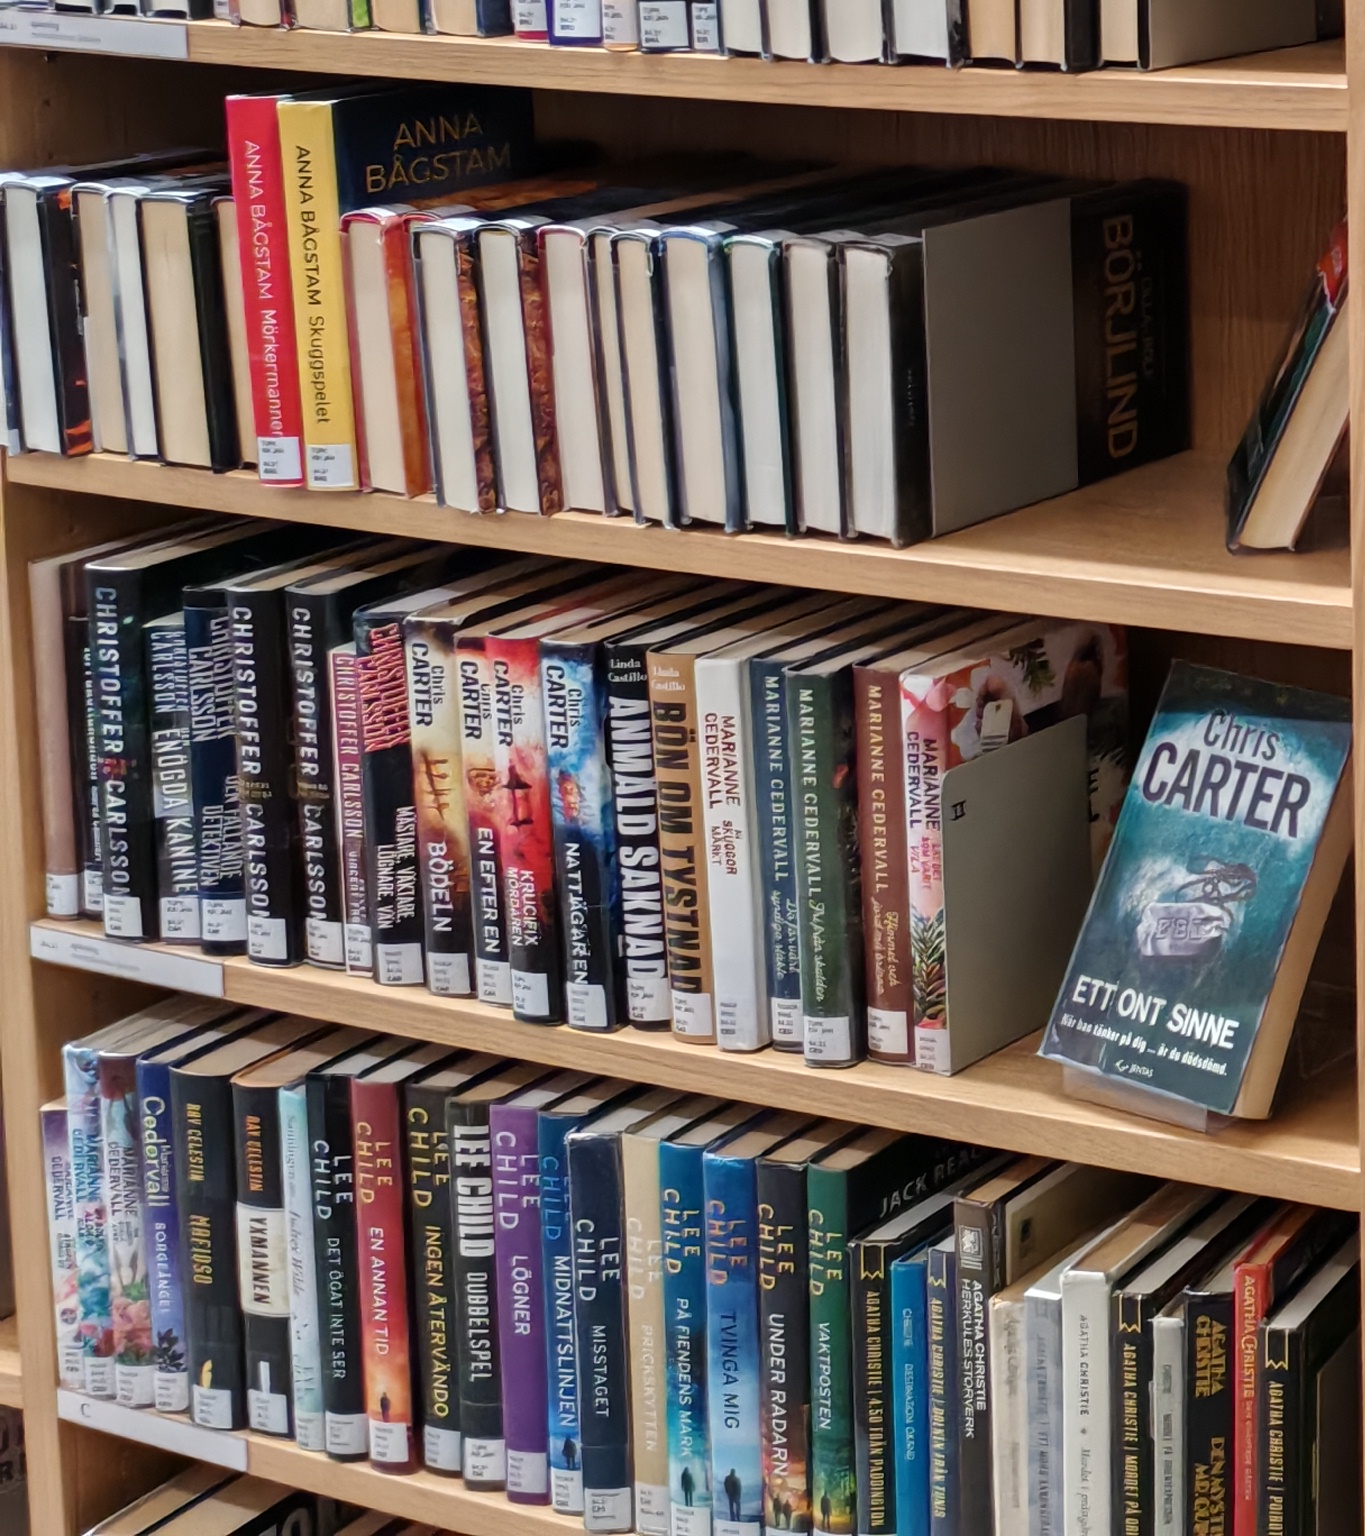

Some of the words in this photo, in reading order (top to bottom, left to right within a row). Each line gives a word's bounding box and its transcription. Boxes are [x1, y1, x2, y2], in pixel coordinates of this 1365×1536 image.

[243, 141, 264, 200] ANNA
[295, 145, 314, 205] ANNA
[365, 143, 513, 194] BÅGSTAM
[393, 112, 483, 151] ANNA
[249, 205, 273, 300] BÅGSTAM
[301, 211, 322, 305] BÅGSTAM
[307, 316, 331, 423] Skuggspelet
[1103, 213, 1139, 458] BÖRJLIND
[96, 588, 123, 761] CHRISTOFFER
[411, 643, 433, 727] CARTER
[547, 665, 570, 750] CARTER
[609, 697, 655, 837] ANMÄLD
[703, 713, 722, 809] CEDERVALL
[720, 716, 741, 807] MARIANNE
[868, 684, 885, 781] MARIANNE
[1203, 709, 1280, 763] Chris
[1141, 741, 1313, 840] CARTER
[871, 789, 889, 893] CEDERVALL
[427, 842, 453, 932] BÖDELN
[564, 842, 588, 985] NATTJÄGAREN
[621, 845, 664, 979] SAKNAD
[1072, 976, 1114, 1009] ETT
[1118, 987, 1166, 1024] ONT
[1171, 1001, 1239, 1050] SINNE
[454, 1125, 489, 1172] LEE
[370, 1226, 385, 1247] EN
[457, 1177, 493, 1256] CHILD
[372, 1255, 387, 1321] ANNAN
[468, 1272, 492, 1382] DUBBELSPEL
[512, 1255, 531, 1336] LÖGNER
[376, 1328, 389, 1355] TID
[554, 1256, 577, 1428] MIDNATTSLINJEN
[592, 1325, 609, 1417] MISSTAGET
[720, 1311, 738, 1387] TVINGA
[769, 1314, 785, 1382] UNDER
[817, 1324, 832, 1431] VAKTPOSTEN
[723, 1392, 740, 1429] MIG
[772, 1388, 788, 1478] RADARN
